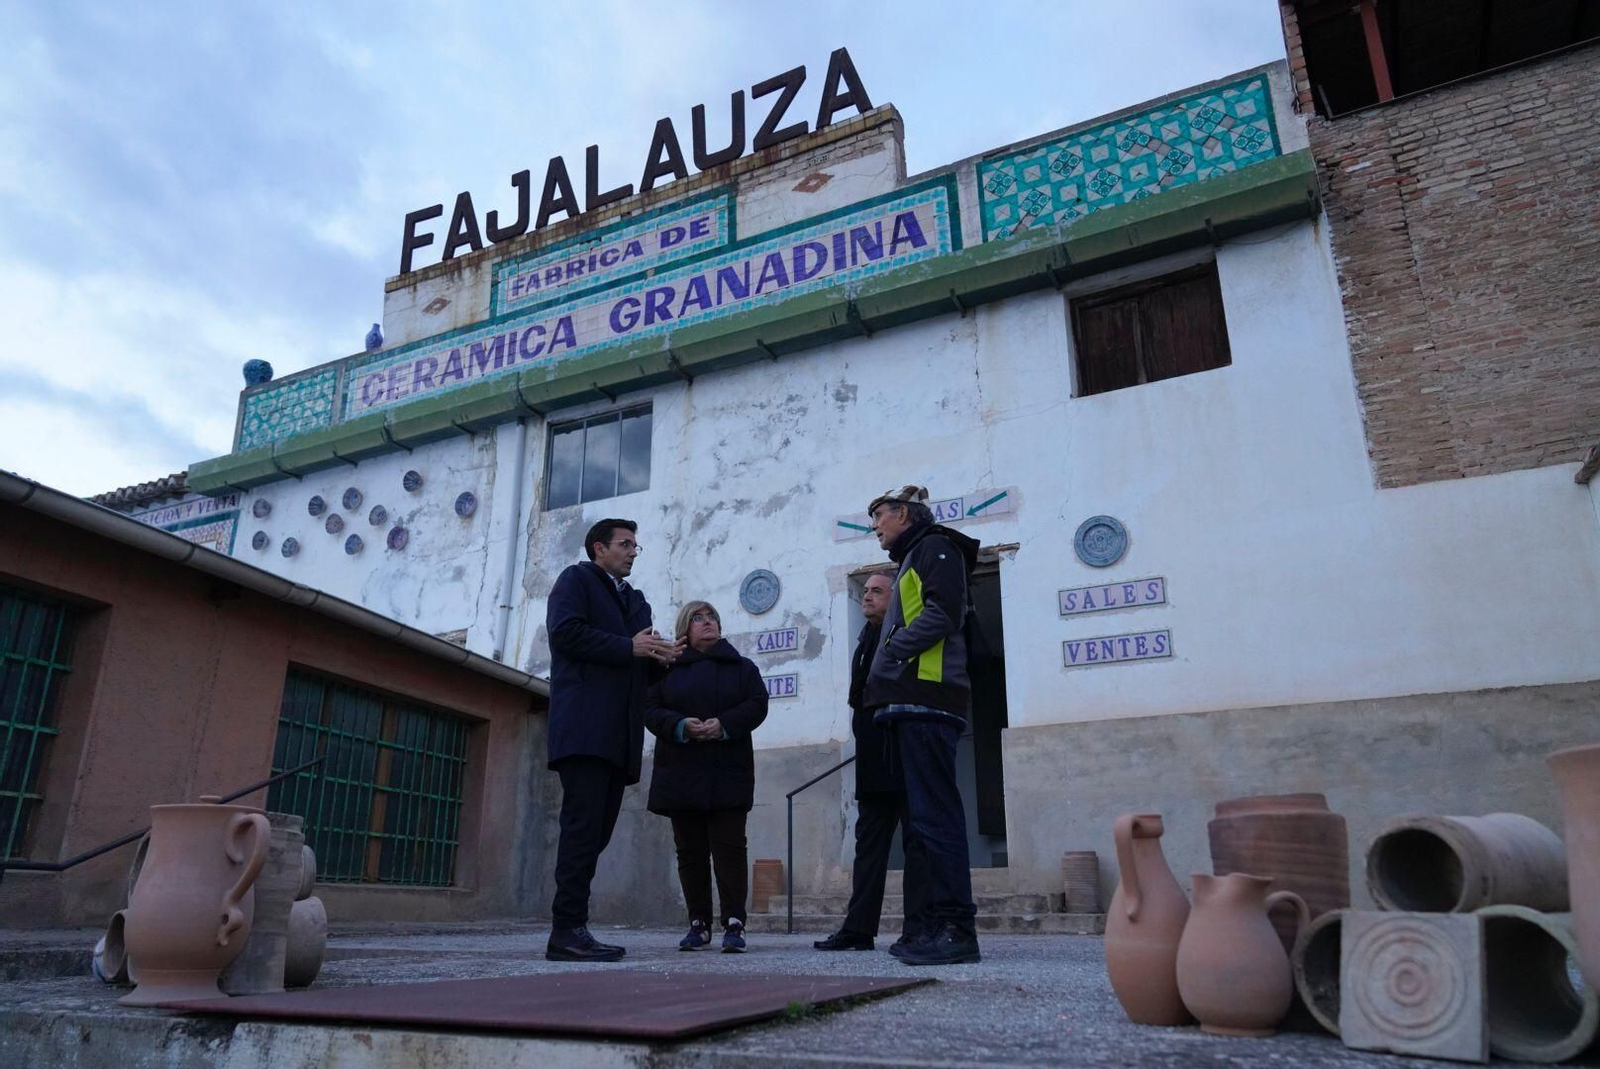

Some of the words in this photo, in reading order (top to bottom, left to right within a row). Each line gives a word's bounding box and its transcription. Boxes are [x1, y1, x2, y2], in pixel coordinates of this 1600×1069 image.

[400, 46, 874, 274] FAJALAUZA
[511, 239, 644, 297] FABRICA
[659, 216, 711, 249] DE
[361, 315, 578, 406] CERAMICA
[609, 211, 928, 334] GRANADINA
[187, 504, 193, 516] Y
[198, 494, 236, 515] VENTA
[934, 501, 959, 521] AS
[1064, 582, 1159, 611] SALES
[1067, 634, 1166, 663] VENTES
[764, 677, 795, 696] ITE
